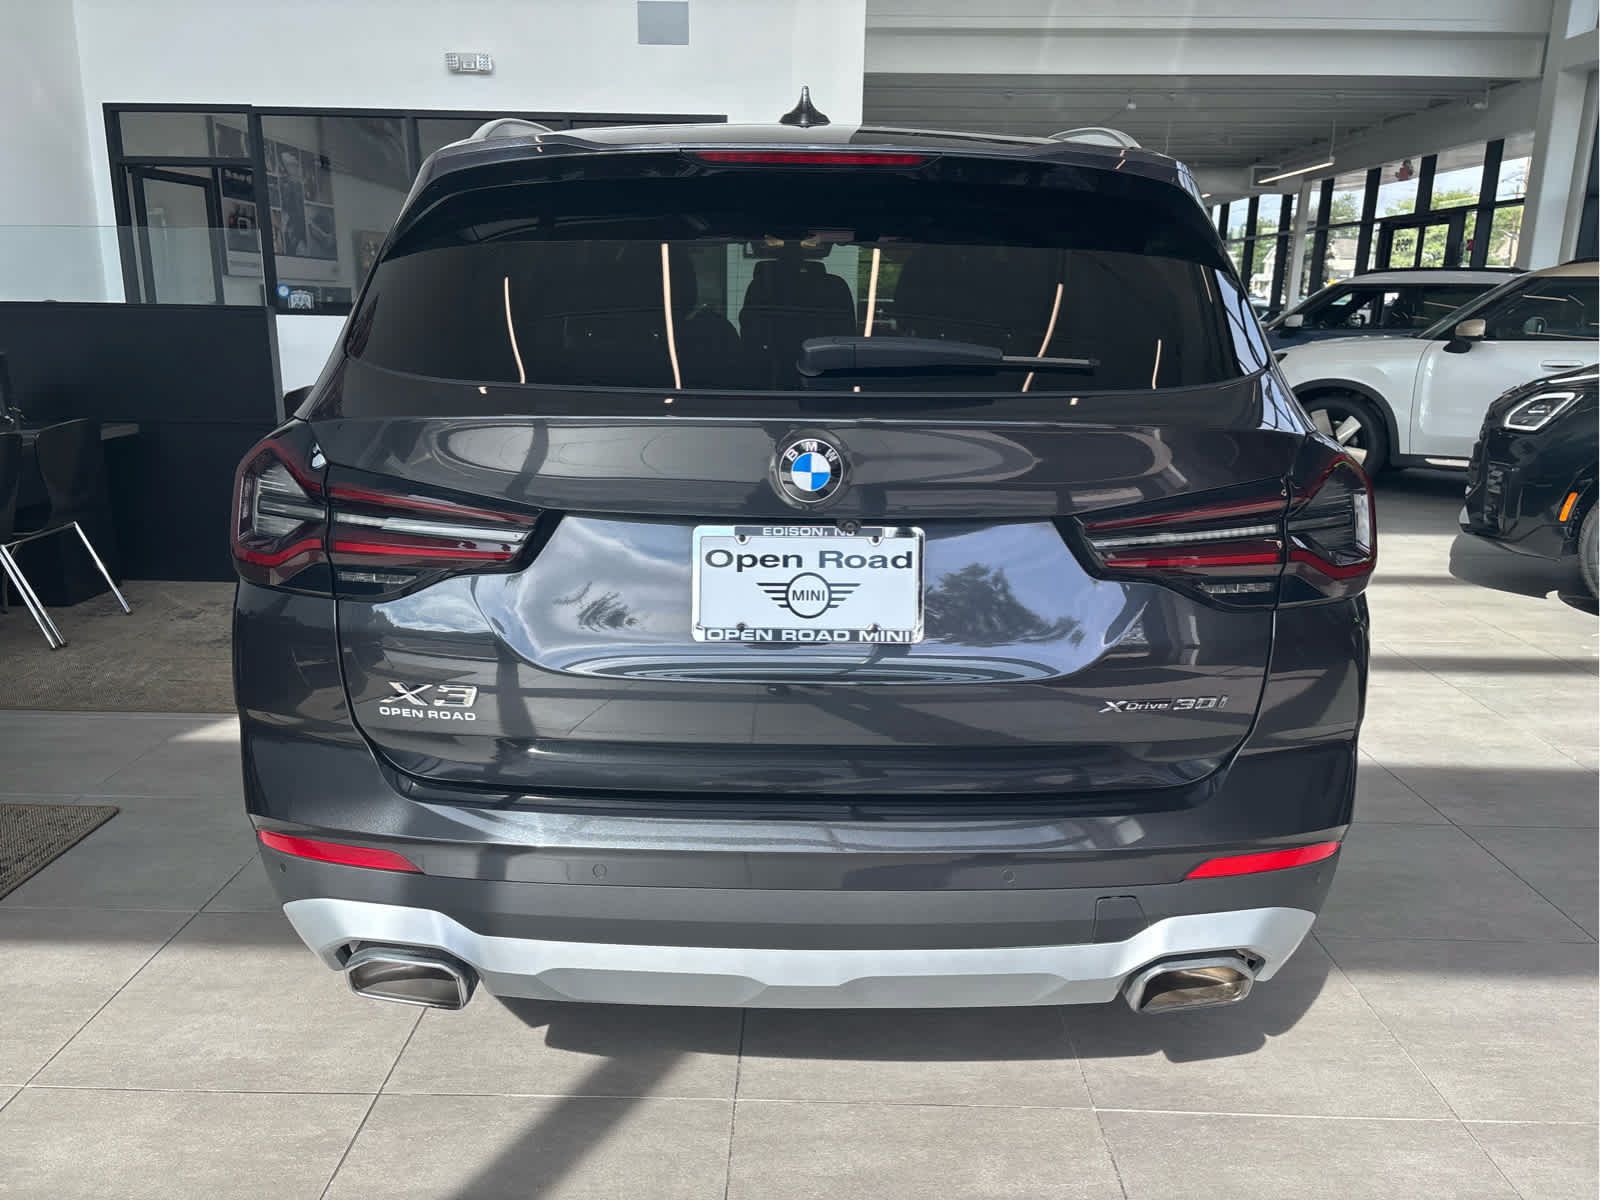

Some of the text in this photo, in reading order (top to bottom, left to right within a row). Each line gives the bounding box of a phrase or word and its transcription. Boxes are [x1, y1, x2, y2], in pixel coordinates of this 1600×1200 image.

[786, 441, 839, 462] BMW
[705, 549, 913, 572] Open Road
[792, 589, 825, 602] MINI
[706, 628, 910, 642] OPEN ROAD MINI
[380, 681, 478, 707] X3
[379, 706, 476, 721] OPEN ROAD
